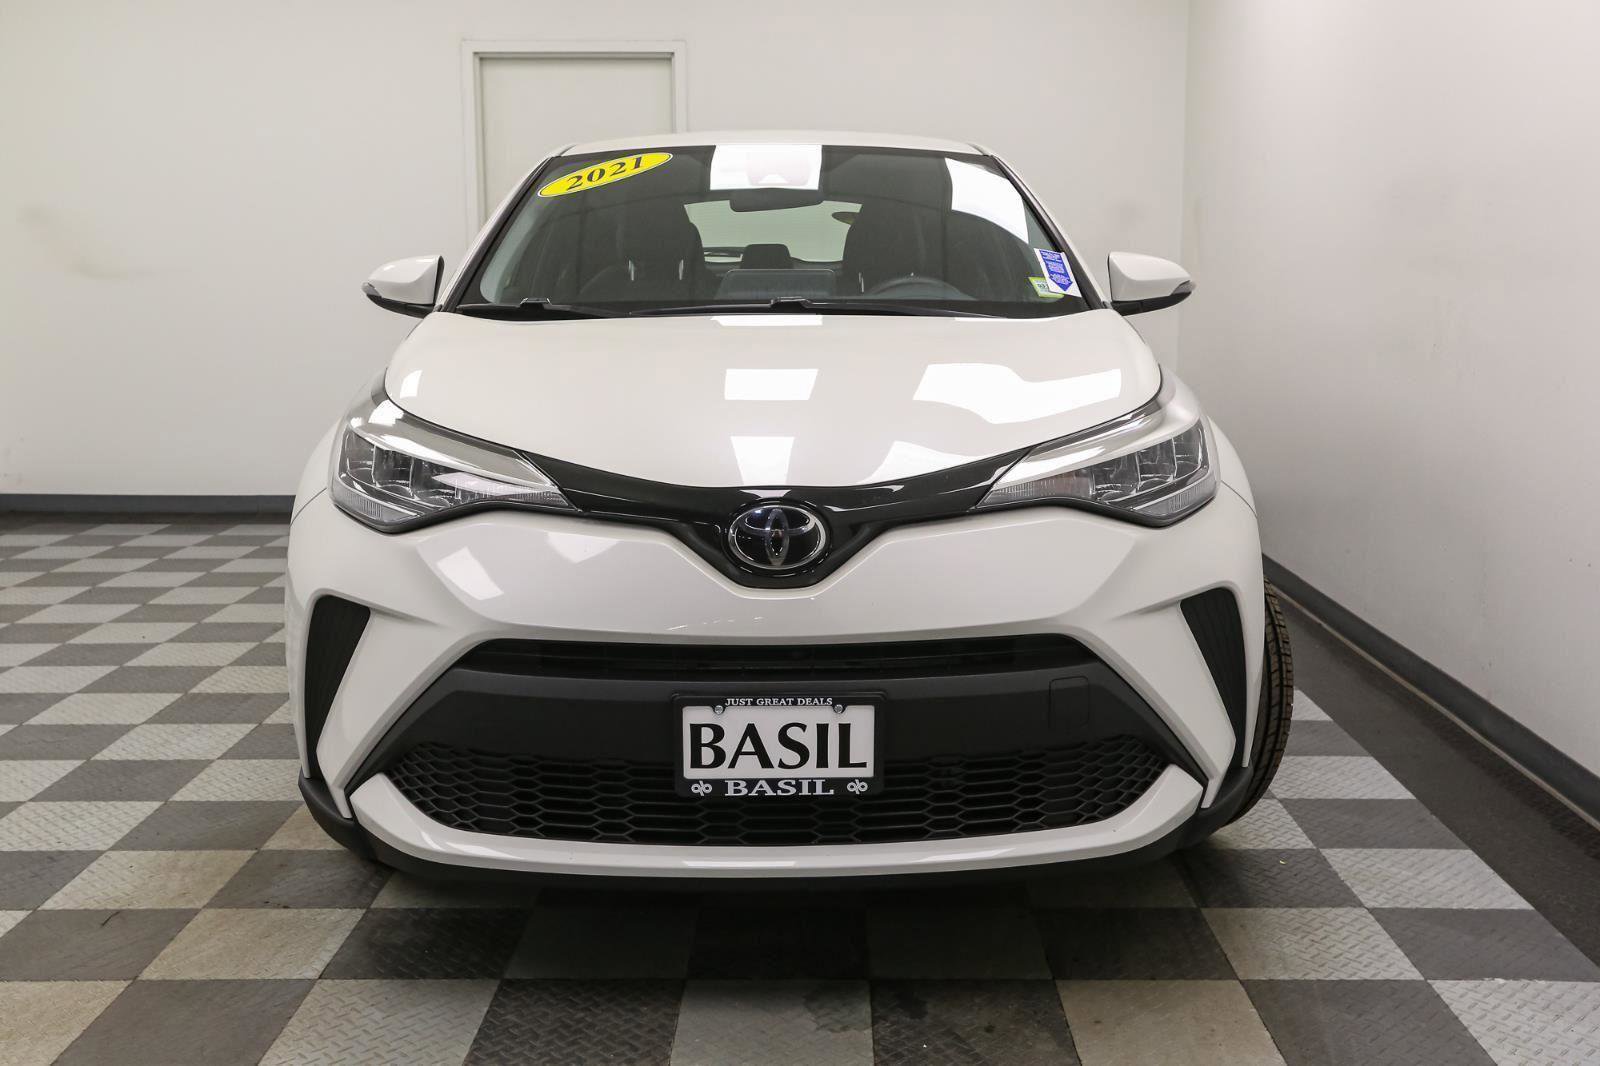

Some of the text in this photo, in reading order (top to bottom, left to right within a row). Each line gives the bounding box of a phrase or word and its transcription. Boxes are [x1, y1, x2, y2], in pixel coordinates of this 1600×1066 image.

[566, 156, 642, 191] 2021
[725, 697, 833, 706] JUST GREAT DEALS
[689, 722, 868, 770] BASIL
[724, 779, 835, 796] BASIL
